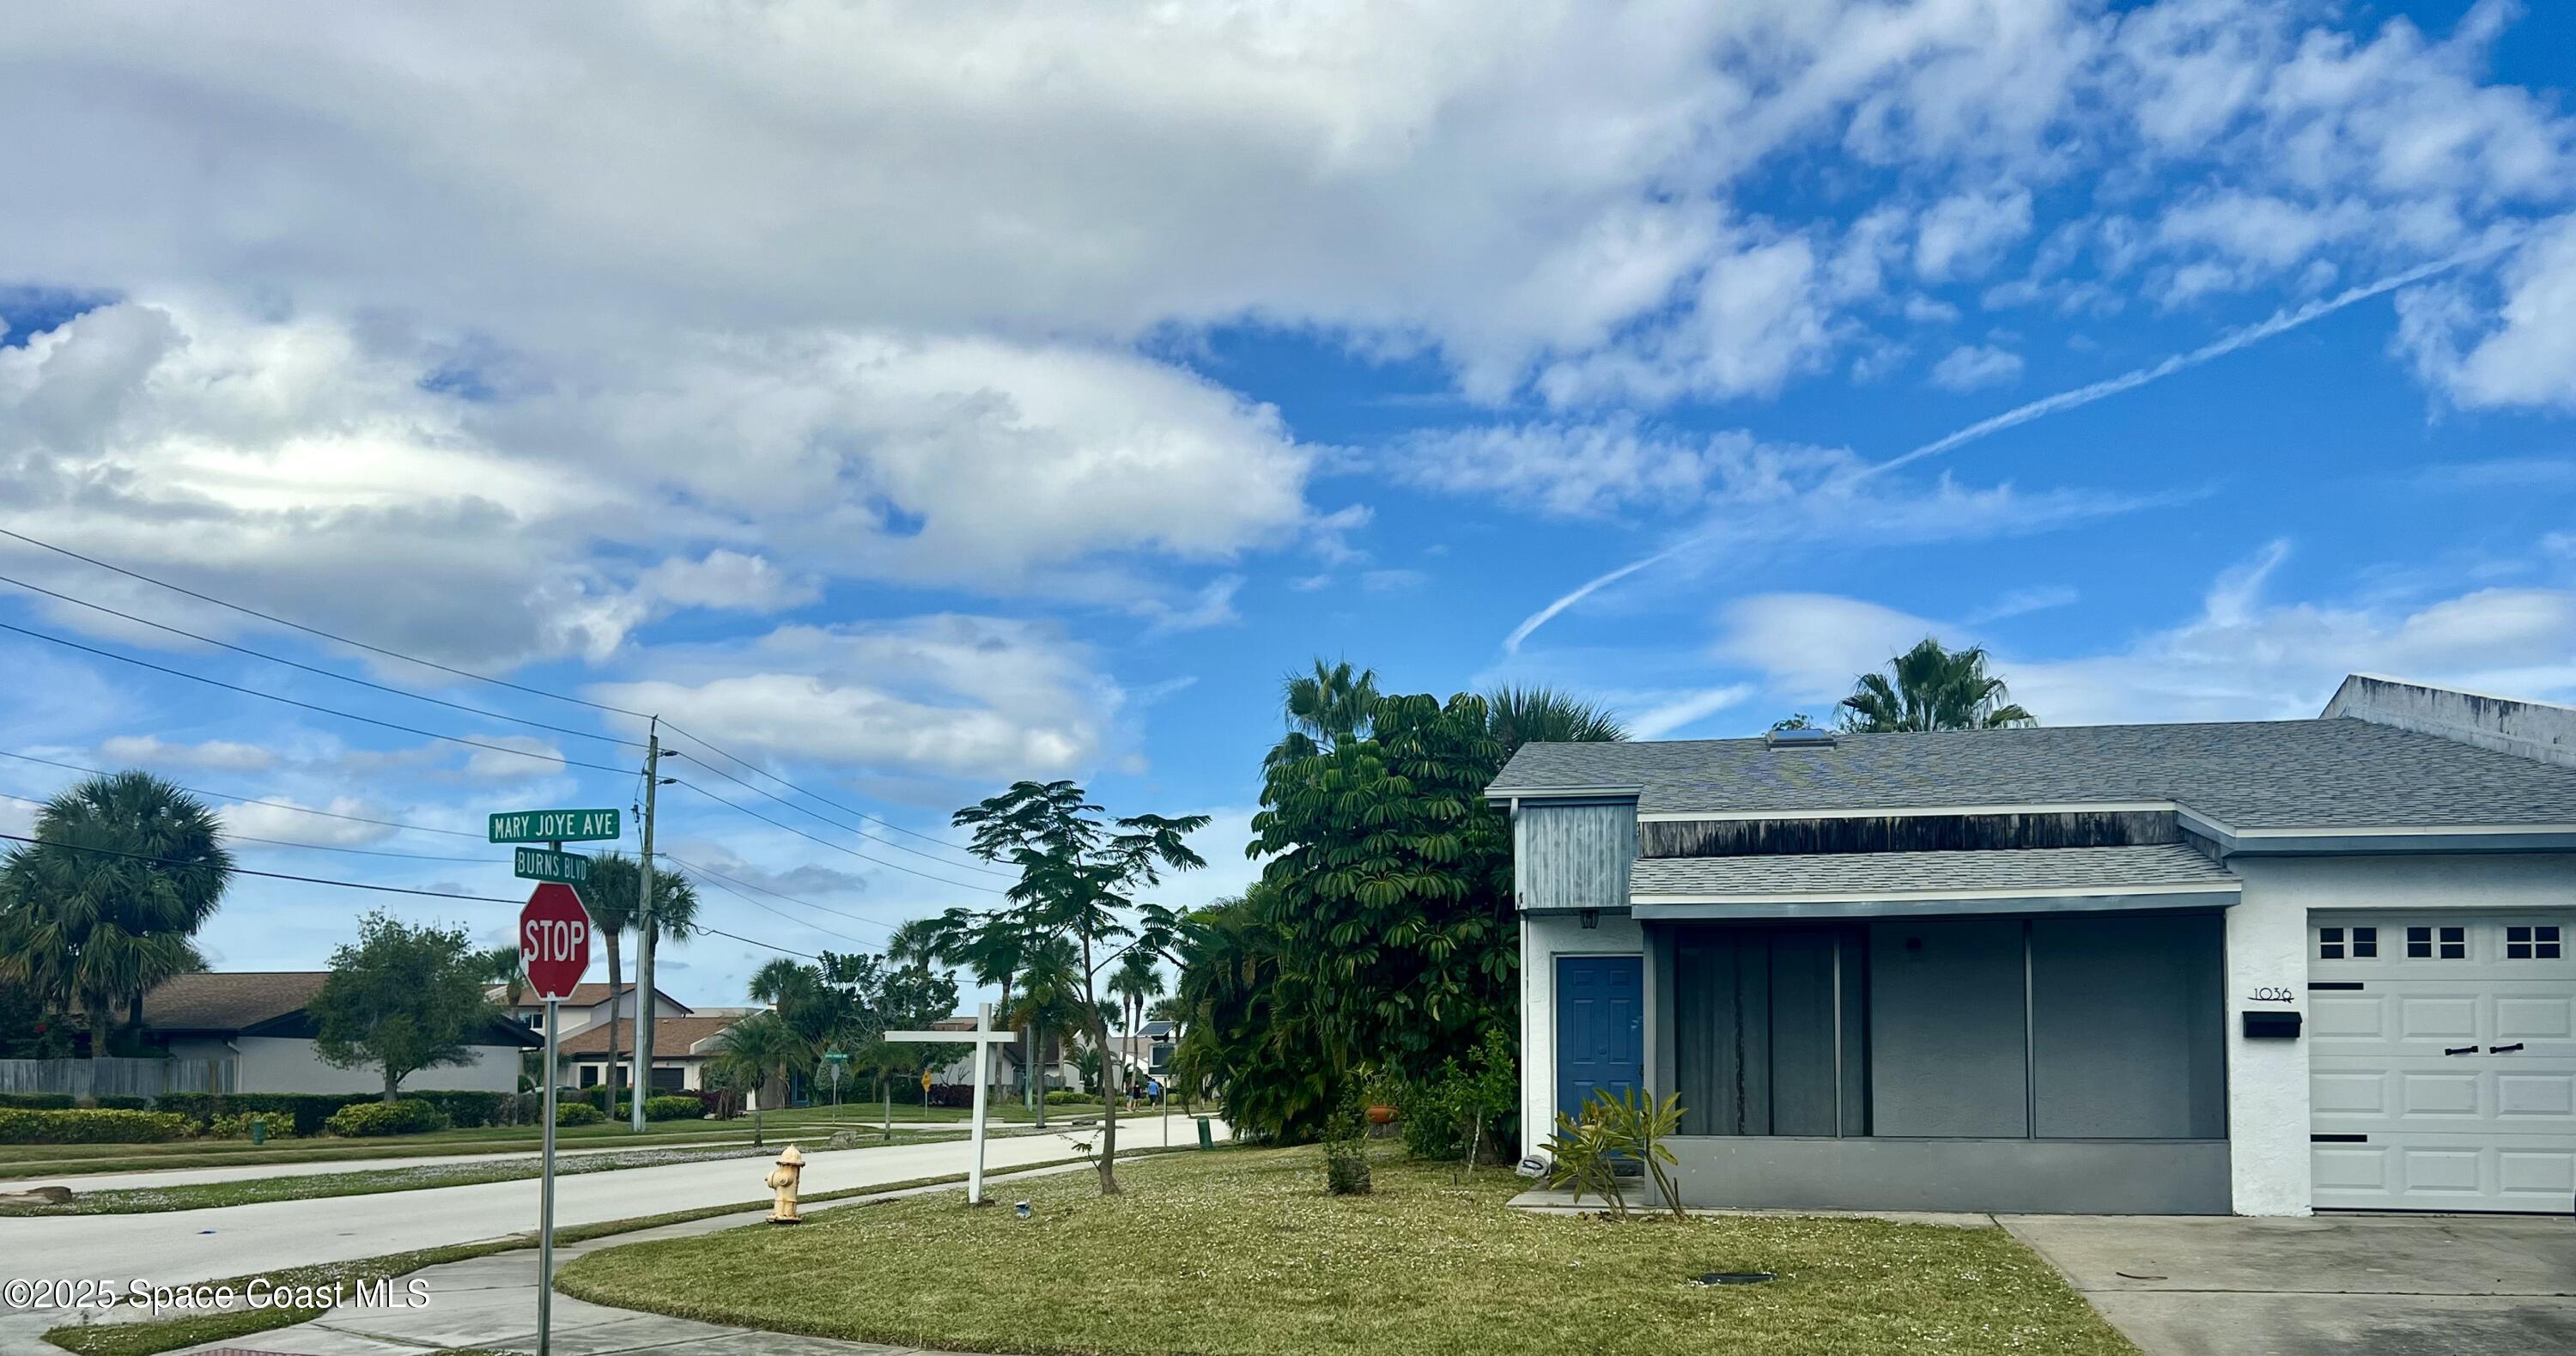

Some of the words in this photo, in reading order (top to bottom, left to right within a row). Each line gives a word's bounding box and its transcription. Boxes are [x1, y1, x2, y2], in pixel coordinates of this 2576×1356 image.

[495, 816, 530, 839] MARY
[535, 813, 575, 836] JOYE
[582, 812, 613, 836] AVE
[517, 850, 559, 877] BURNS
[564, 856, 587, 881] BLVD
[525, 918, 586, 963] STOP
[2253, 987, 2293, 1000] 1036
